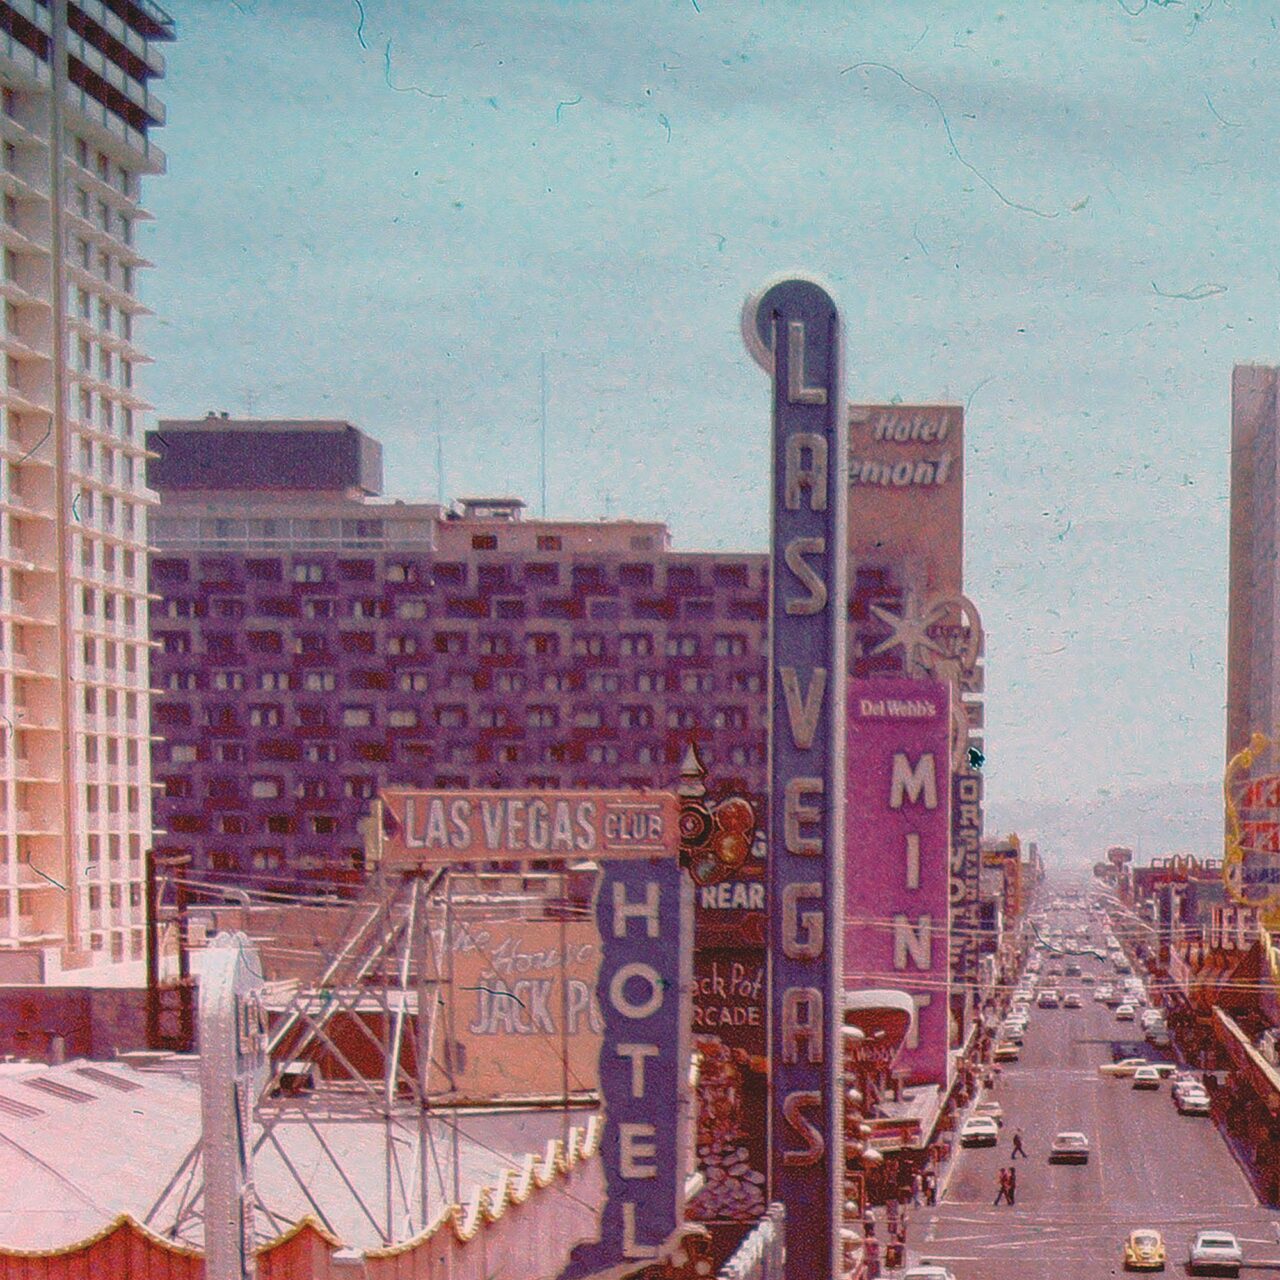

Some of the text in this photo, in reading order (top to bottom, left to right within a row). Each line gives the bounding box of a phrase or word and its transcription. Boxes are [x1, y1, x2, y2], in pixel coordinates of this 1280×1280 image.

[874, 413, 950, 442] Hotel
[848, 451, 954, 487] emont
[779, 321, 828, 1167] LAS VEGAS
[404, 798, 664, 850] LAS VEGAS CLUB
[890, 751, 937, 1050] MINT
[470, 972, 555, 1035] JACK
[731, 962, 764, 999] Pot
[692, 1006, 760, 1025] RCADE
[609, 882, 664, 1258] HOTEL
